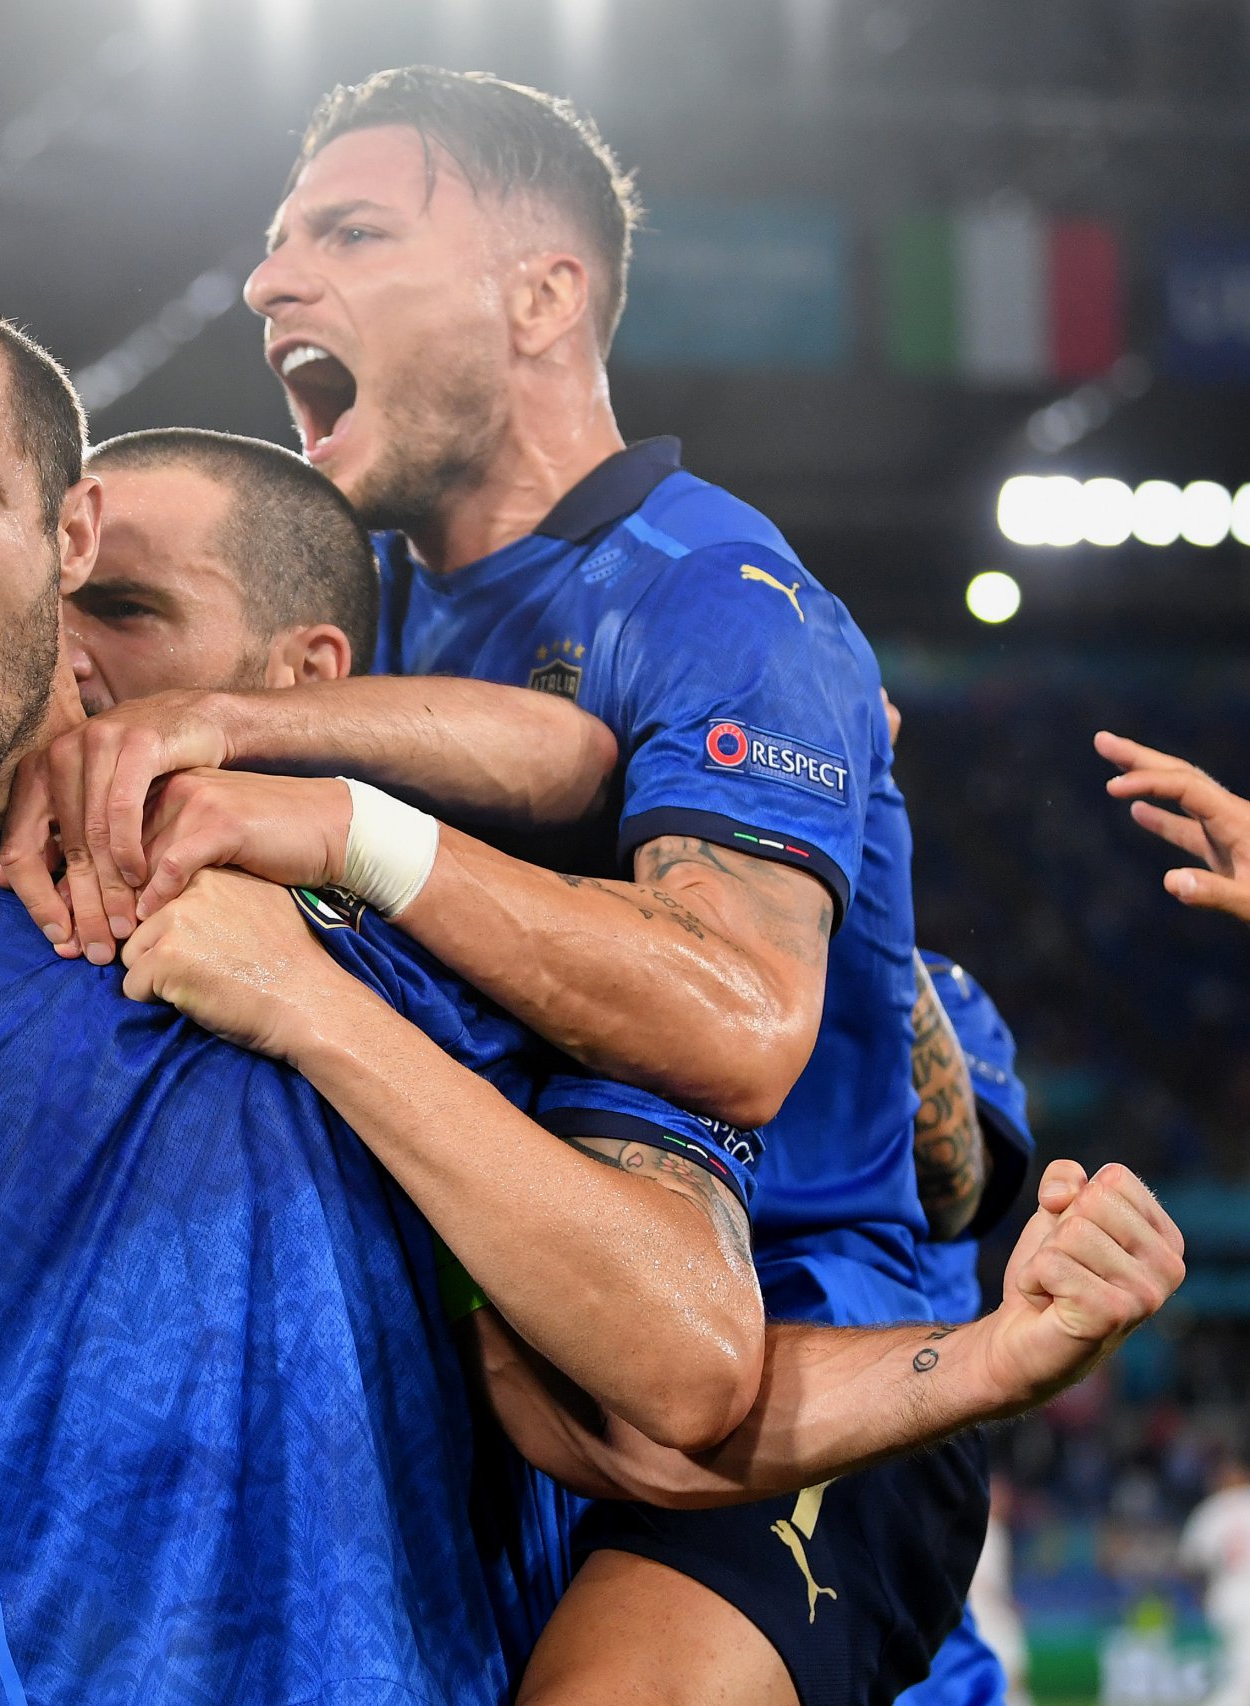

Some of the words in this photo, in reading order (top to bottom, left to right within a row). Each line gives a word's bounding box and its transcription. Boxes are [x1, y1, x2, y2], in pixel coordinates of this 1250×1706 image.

[716, 725, 741, 737] UEFA
[751, 740, 848, 791] RESPECT
[682, 1109, 755, 1165] SPECT
